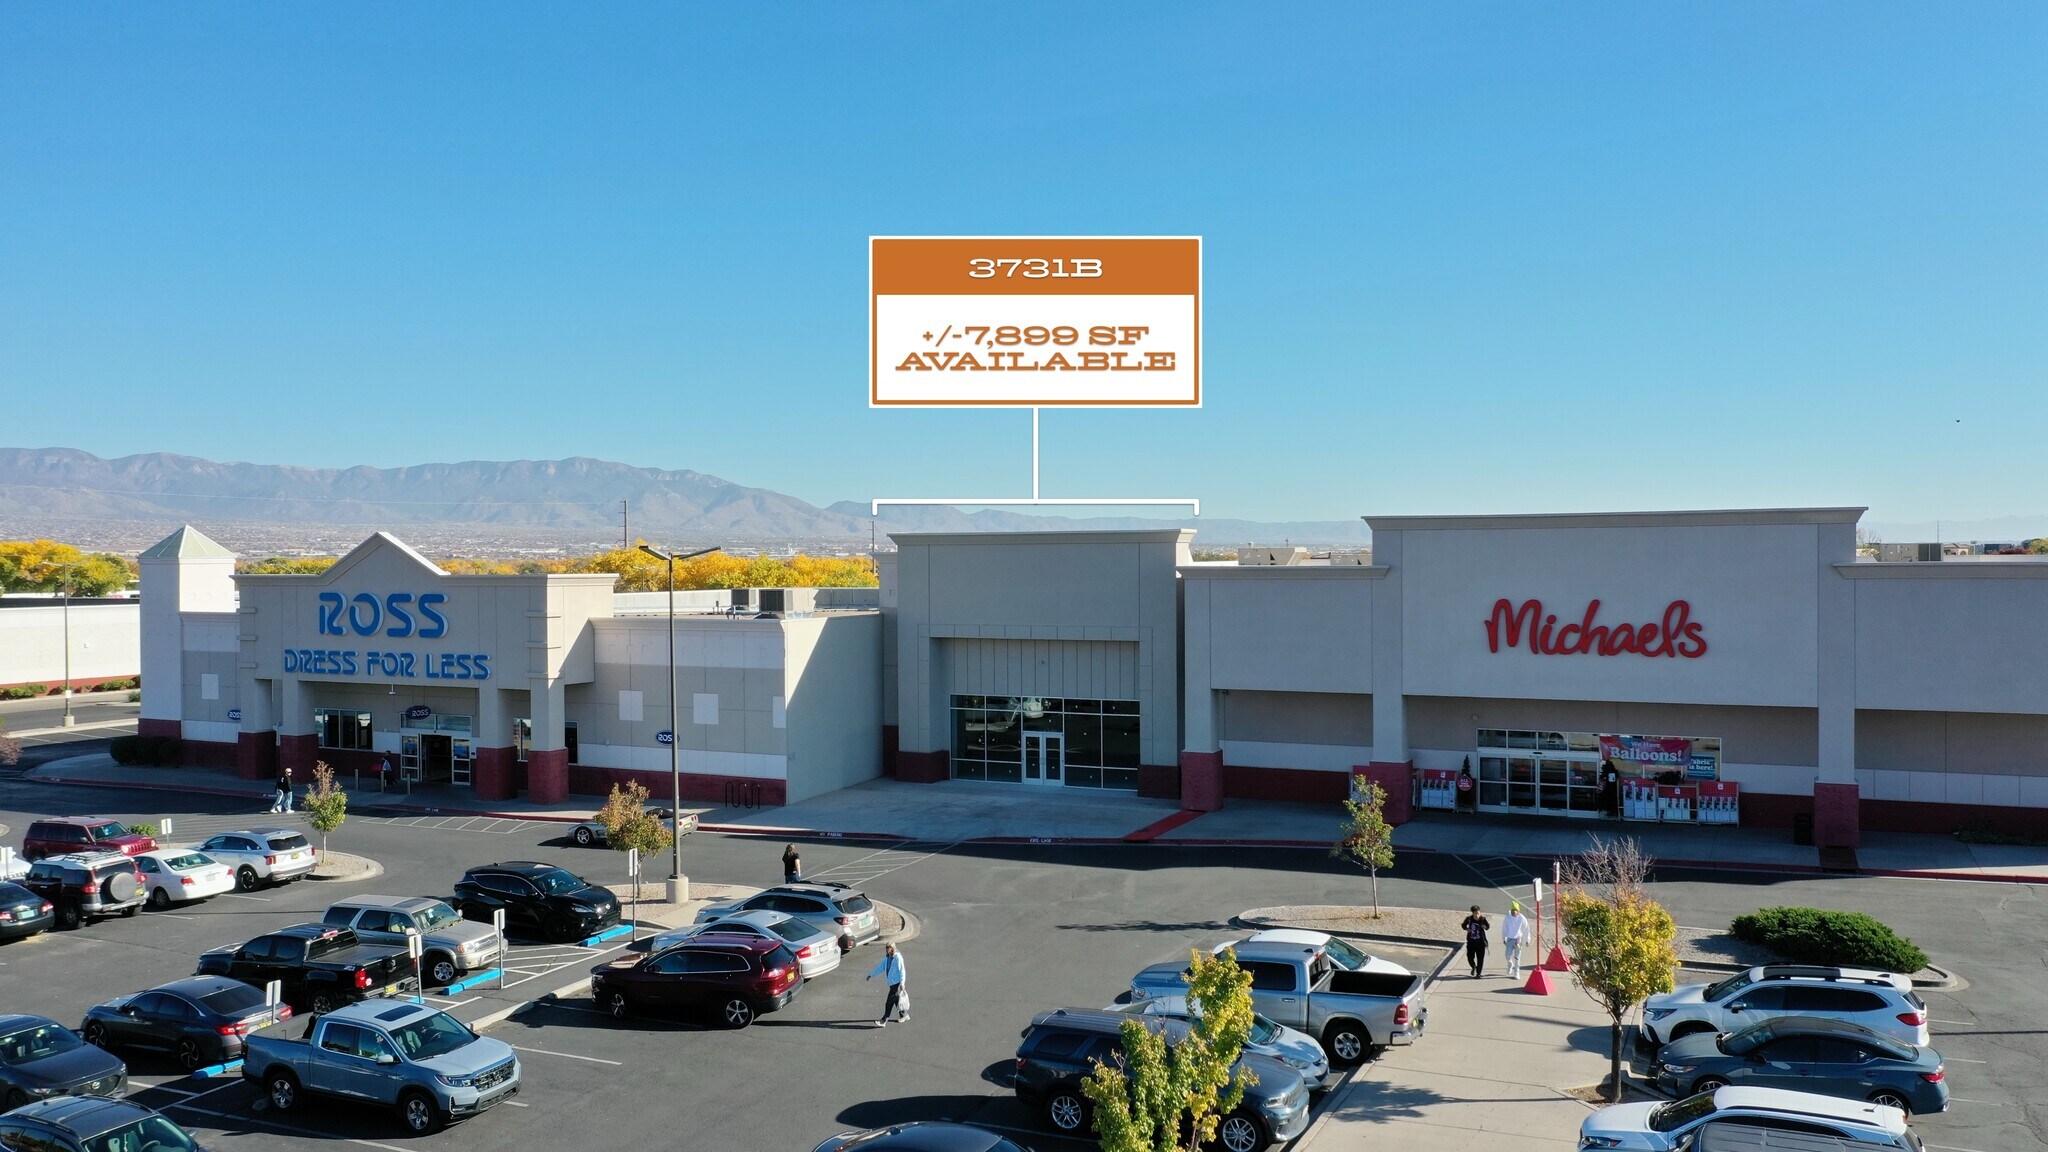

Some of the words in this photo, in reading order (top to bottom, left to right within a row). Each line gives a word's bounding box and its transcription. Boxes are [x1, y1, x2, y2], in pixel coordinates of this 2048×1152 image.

[319, 592, 449, 639] ROSS
[1484, 599, 1708, 659] Michaels
[284, 649, 359, 676] DRESS
[367, 651, 417, 678] FOR
[426, 653, 492, 680] LESS
[412, 709, 429, 717] ROSS
[658, 734, 672, 742] ROS
[1643, 741, 1661, 749] Have
[1609, 746, 1682, 762] Balloons!
